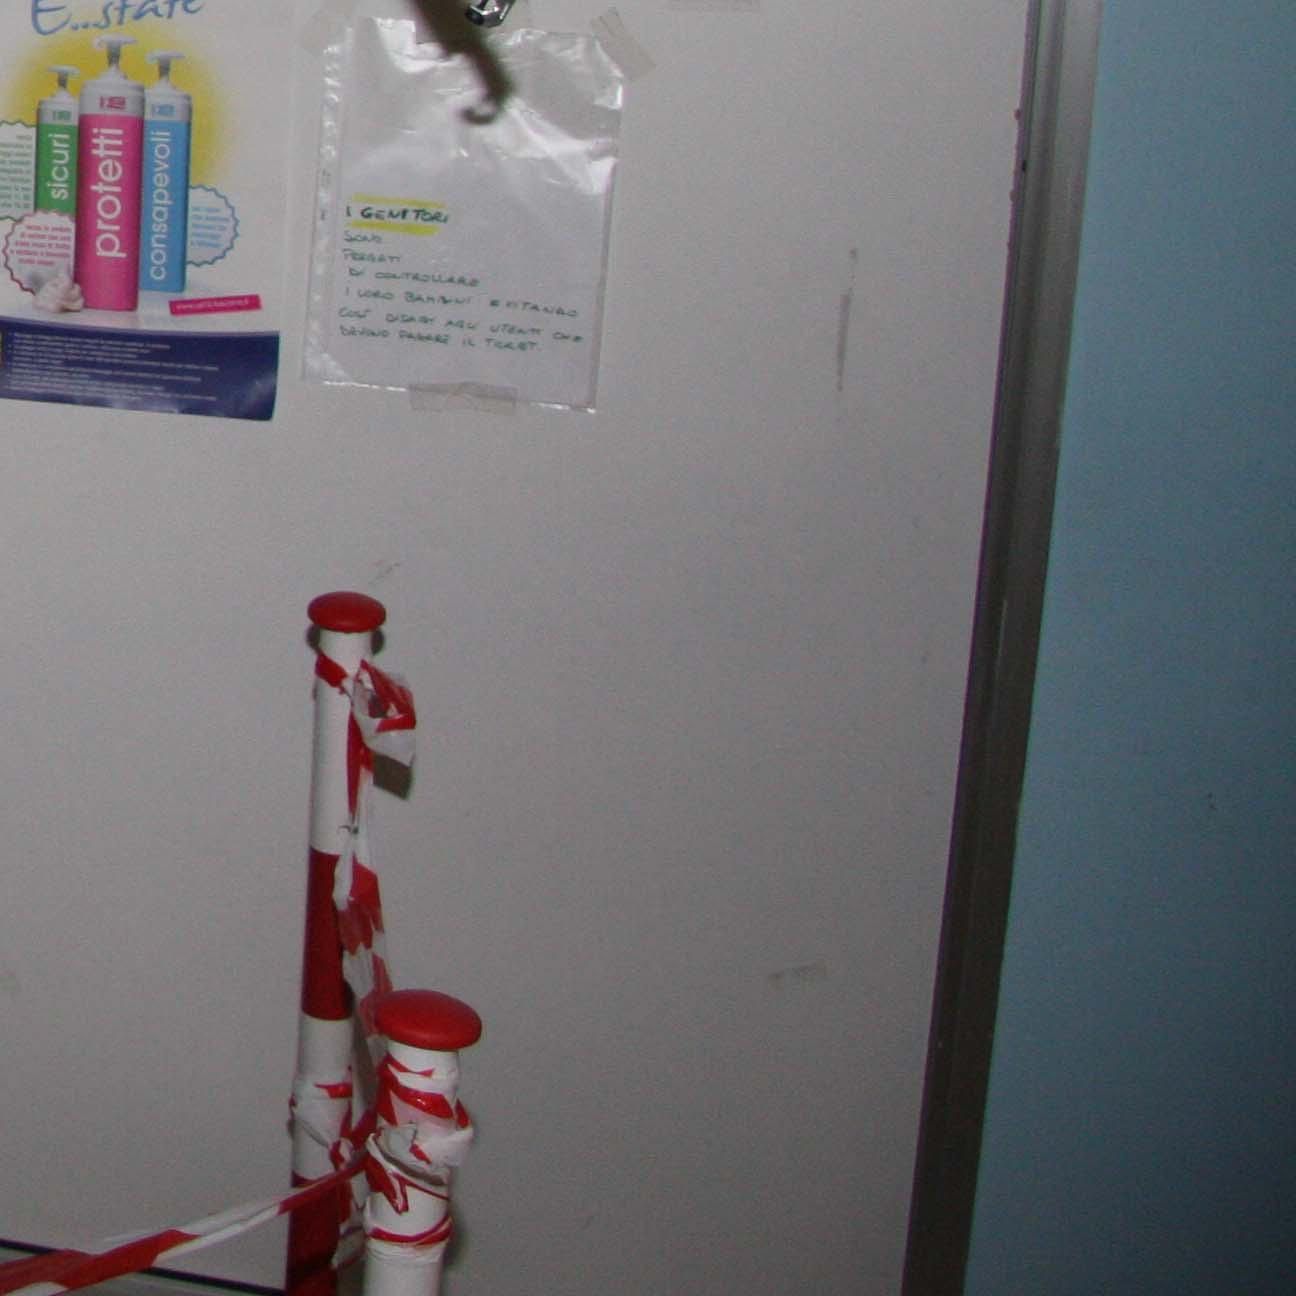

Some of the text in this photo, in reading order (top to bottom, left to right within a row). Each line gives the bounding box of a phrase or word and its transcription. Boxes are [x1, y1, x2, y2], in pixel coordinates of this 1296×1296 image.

[46, 133, 71, 200] sicuri
[91, 128, 127, 258] protetti
[150, 130, 173, 281] consapevoli
[361, 207, 449, 224] GENITORI
